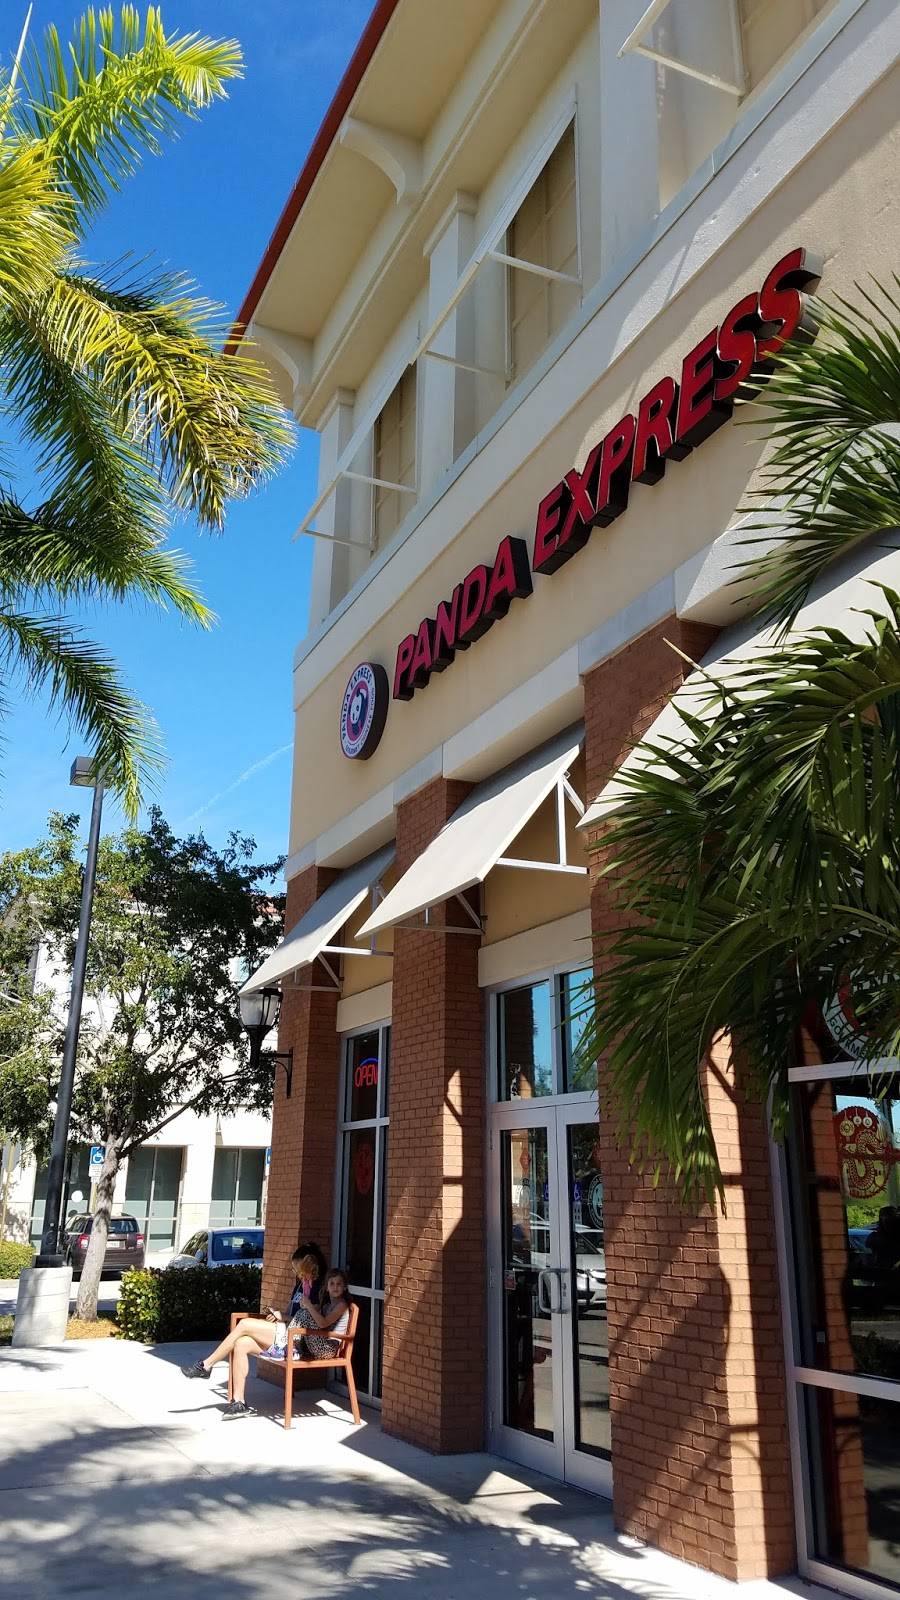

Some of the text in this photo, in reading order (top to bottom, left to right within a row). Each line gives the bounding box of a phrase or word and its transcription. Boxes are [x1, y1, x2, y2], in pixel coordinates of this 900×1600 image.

[393, 246, 808, 700] PANDA EXPRESS
[354, 1063, 378, 1088] OPEN
